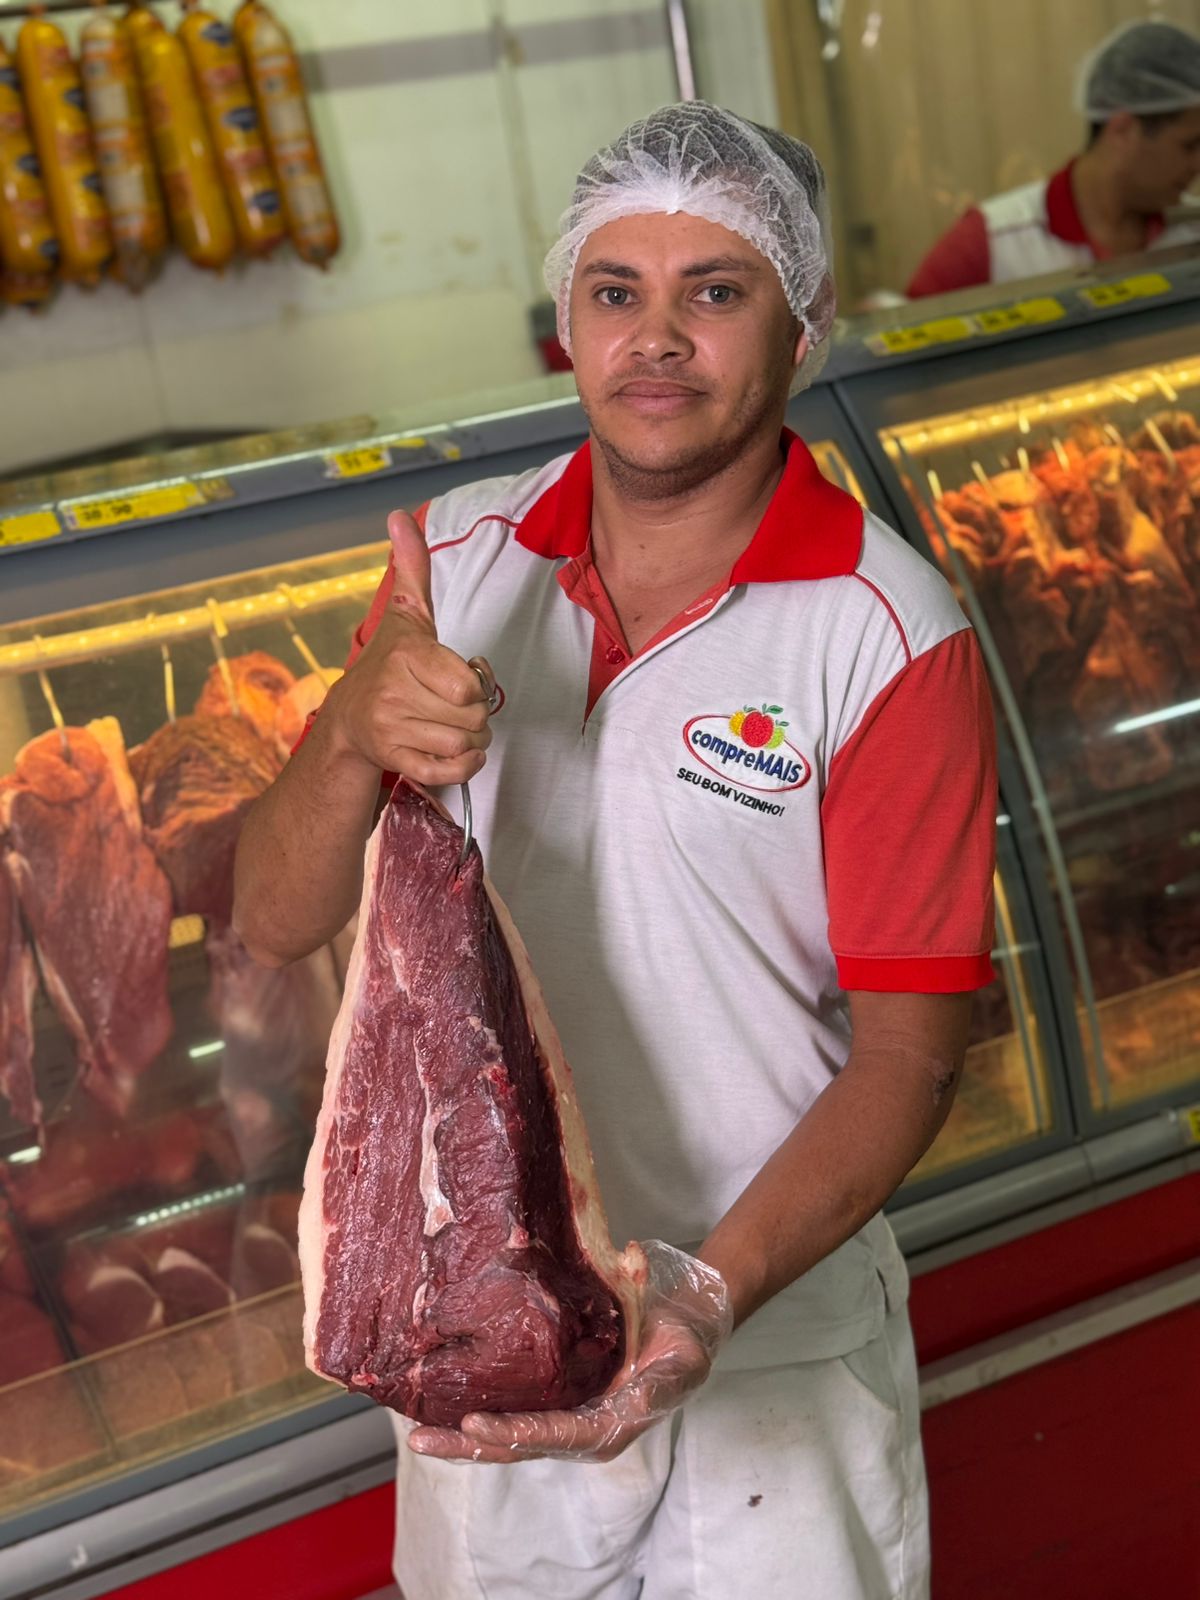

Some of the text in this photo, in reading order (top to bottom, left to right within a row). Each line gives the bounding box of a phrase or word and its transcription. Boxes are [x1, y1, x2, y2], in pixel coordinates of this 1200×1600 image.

[691, 730, 803, 783] compreMAIS
[677, 767, 785, 817] SEU BOM VIZINHO!
